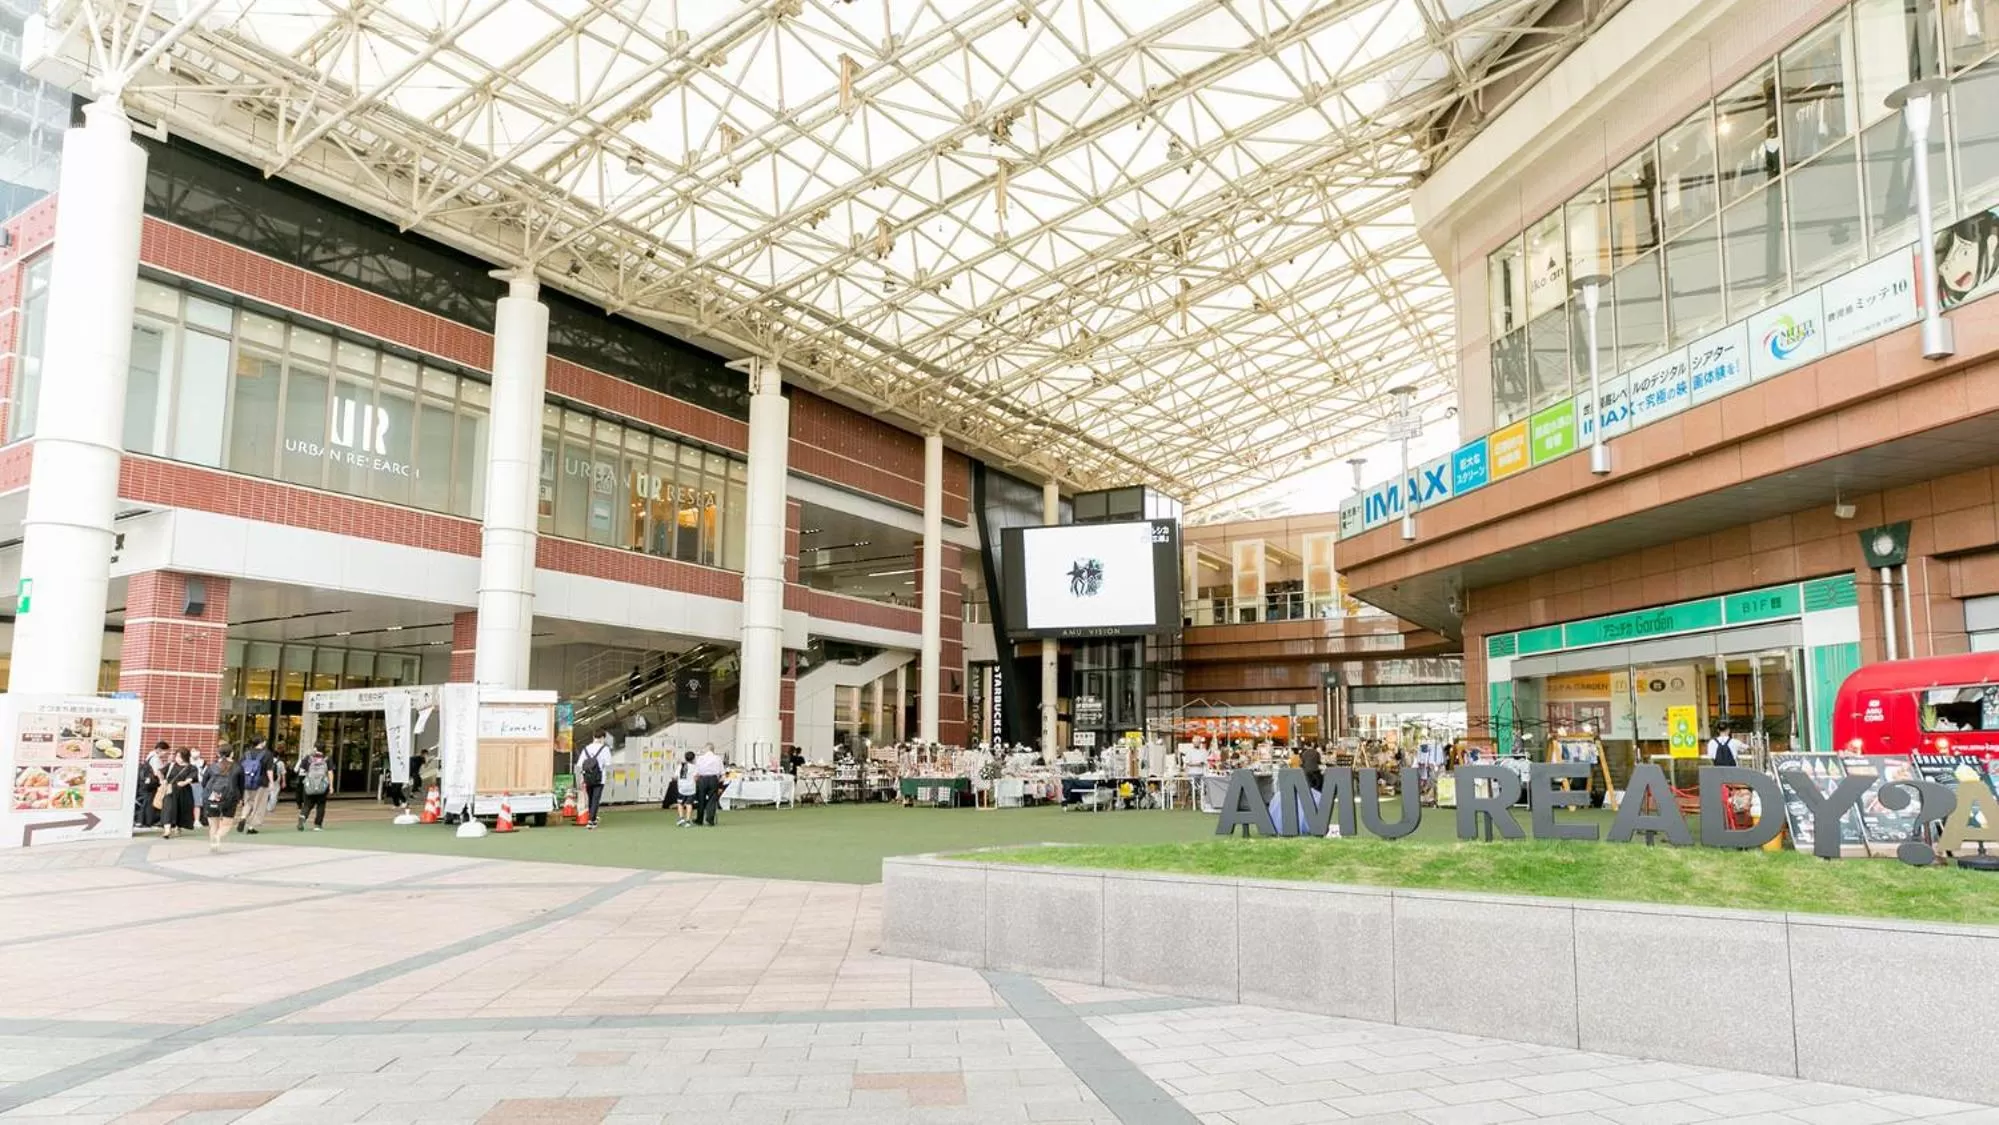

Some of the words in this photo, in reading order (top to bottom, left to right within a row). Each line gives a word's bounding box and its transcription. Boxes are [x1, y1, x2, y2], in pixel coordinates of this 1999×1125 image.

[330, 396, 390, 456] UR
[1364, 463, 1449, 525] IMAX
[1456, 466, 1485, 484] スクリーン
[1062, 629, 1082, 637] AMU
[1088, 628, 1122, 636] VISION
[1636, 613, 1674, 634] Garden
[1743, 599, 1769, 614] B1F
[993, 665, 1002, 734] STARBUCKS
[1215, 767, 1422, 840] AMU
[1455, 762, 1957, 866] READY?
